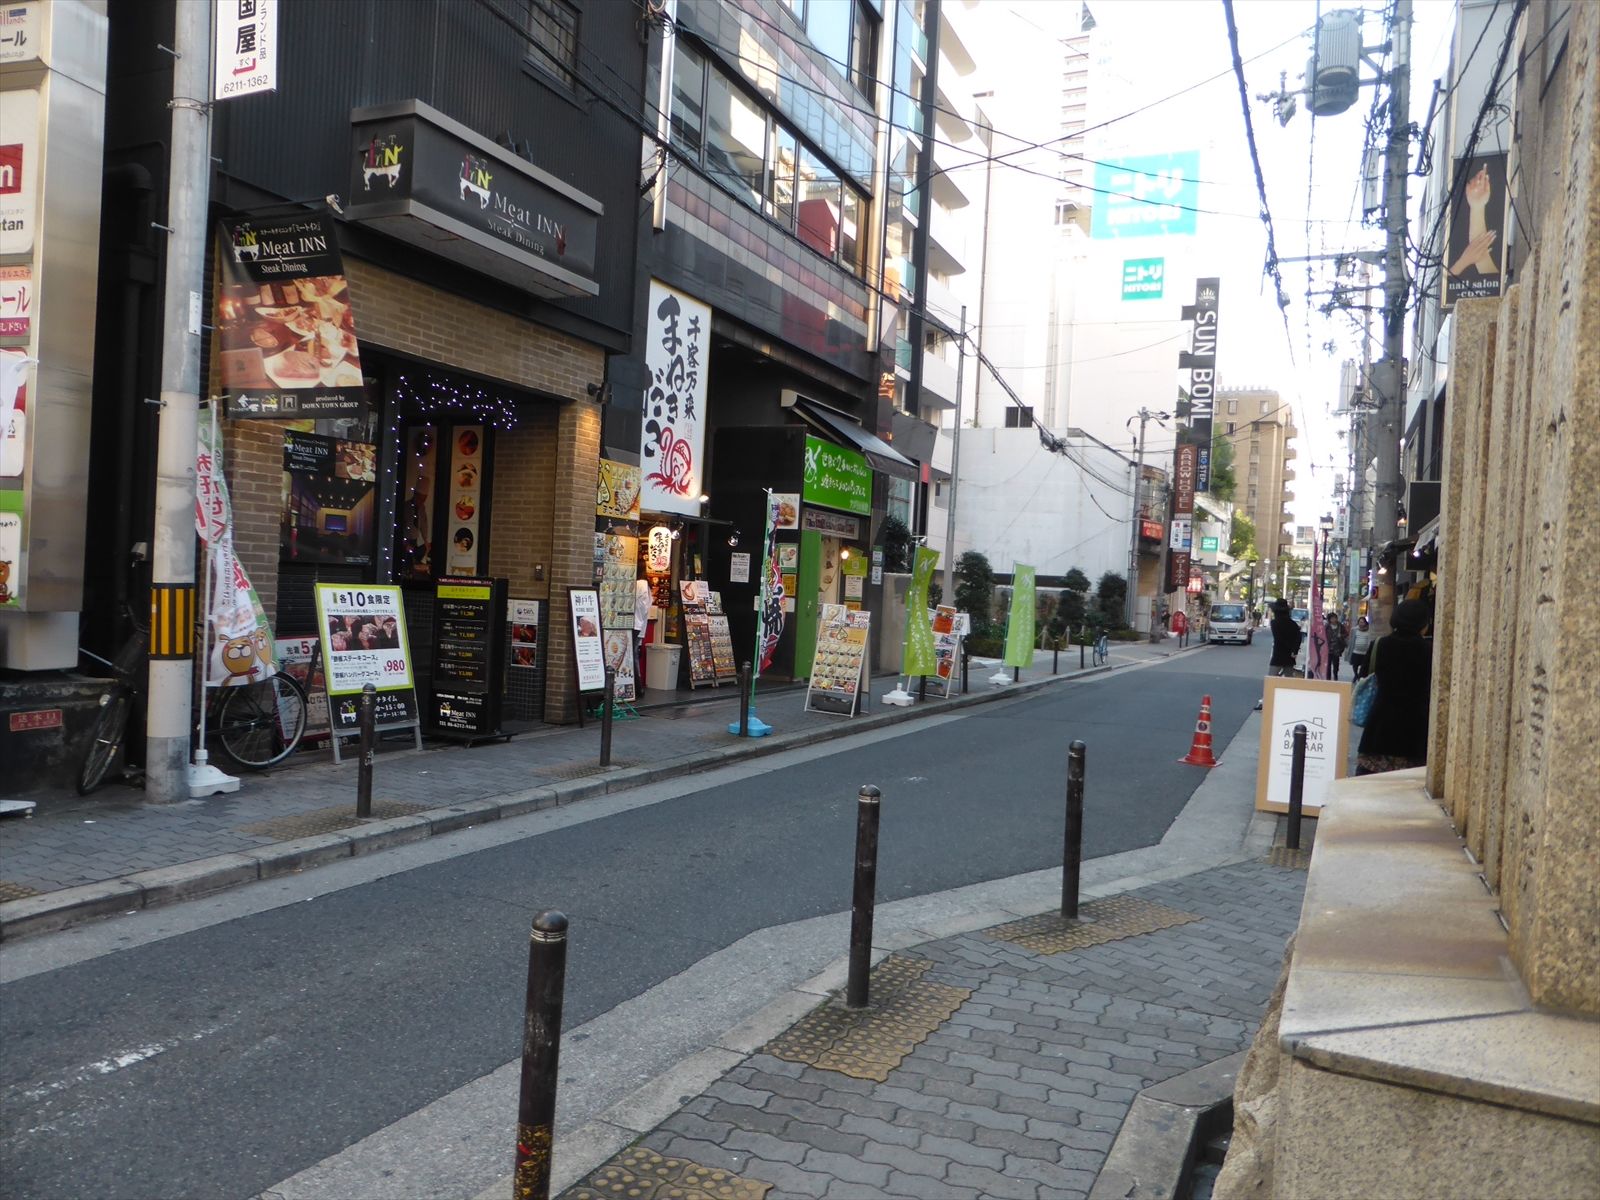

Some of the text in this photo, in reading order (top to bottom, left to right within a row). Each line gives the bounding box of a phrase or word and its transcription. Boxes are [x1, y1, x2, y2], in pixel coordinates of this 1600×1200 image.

[223, 74, 268, 93] 6211-1362
[494, 192, 563, 239] Meat INN
[262, 236, 327, 255] Meat INN
[488, 219, 544, 256] Steak Dining
[261, 263, 308, 273] Steak Dining
[1124, 264, 1162, 282] ニトリ
[1124, 283, 1162, 293] NITORI
[1472, 279, 1499, 289] salon
[683, 315, 701, 421] 千客万来
[1190, 310, 1217, 428] SUN BOWL
[294, 444, 328, 456] Meat INN
[1178, 448, 1192, 509] ARROW HOTEL
[1200, 464, 1208, 482] STEP
[340, 592, 390, 607] 各10食限定
[1285, 730, 1324, 740] AENT
[1284, 740, 1323, 752] BAAAR
